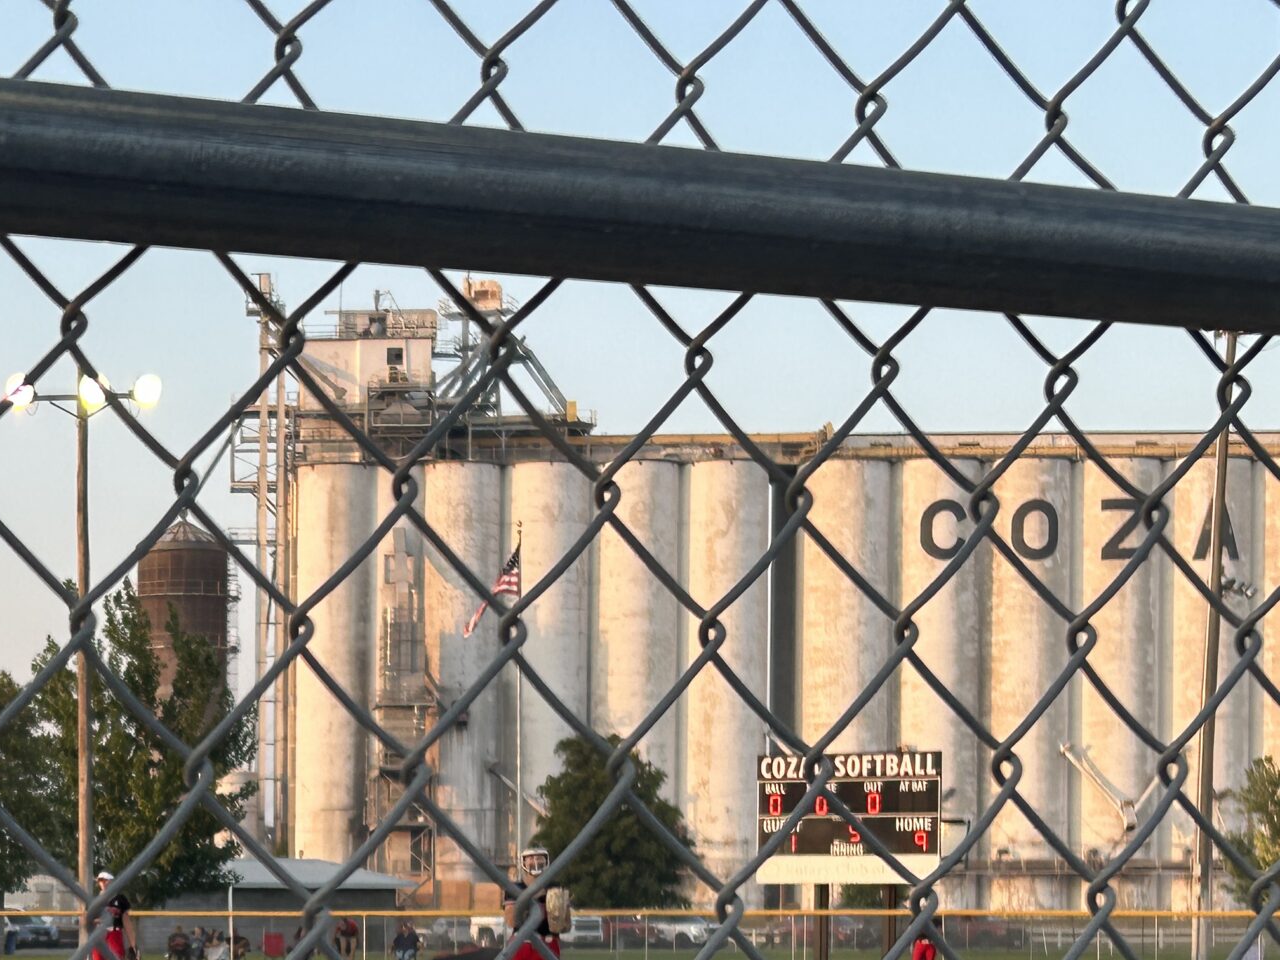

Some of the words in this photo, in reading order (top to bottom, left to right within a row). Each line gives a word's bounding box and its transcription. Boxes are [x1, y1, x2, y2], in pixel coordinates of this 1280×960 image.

[834, 753, 936, 777] SOFTBALL
[863, 781, 883, 793] OUT
[899, 780, 910, 792] AT
[911, 781, 928, 792] BAT
[895, 817, 932, 832] HOME
[830, 842, 863, 856] INNING
